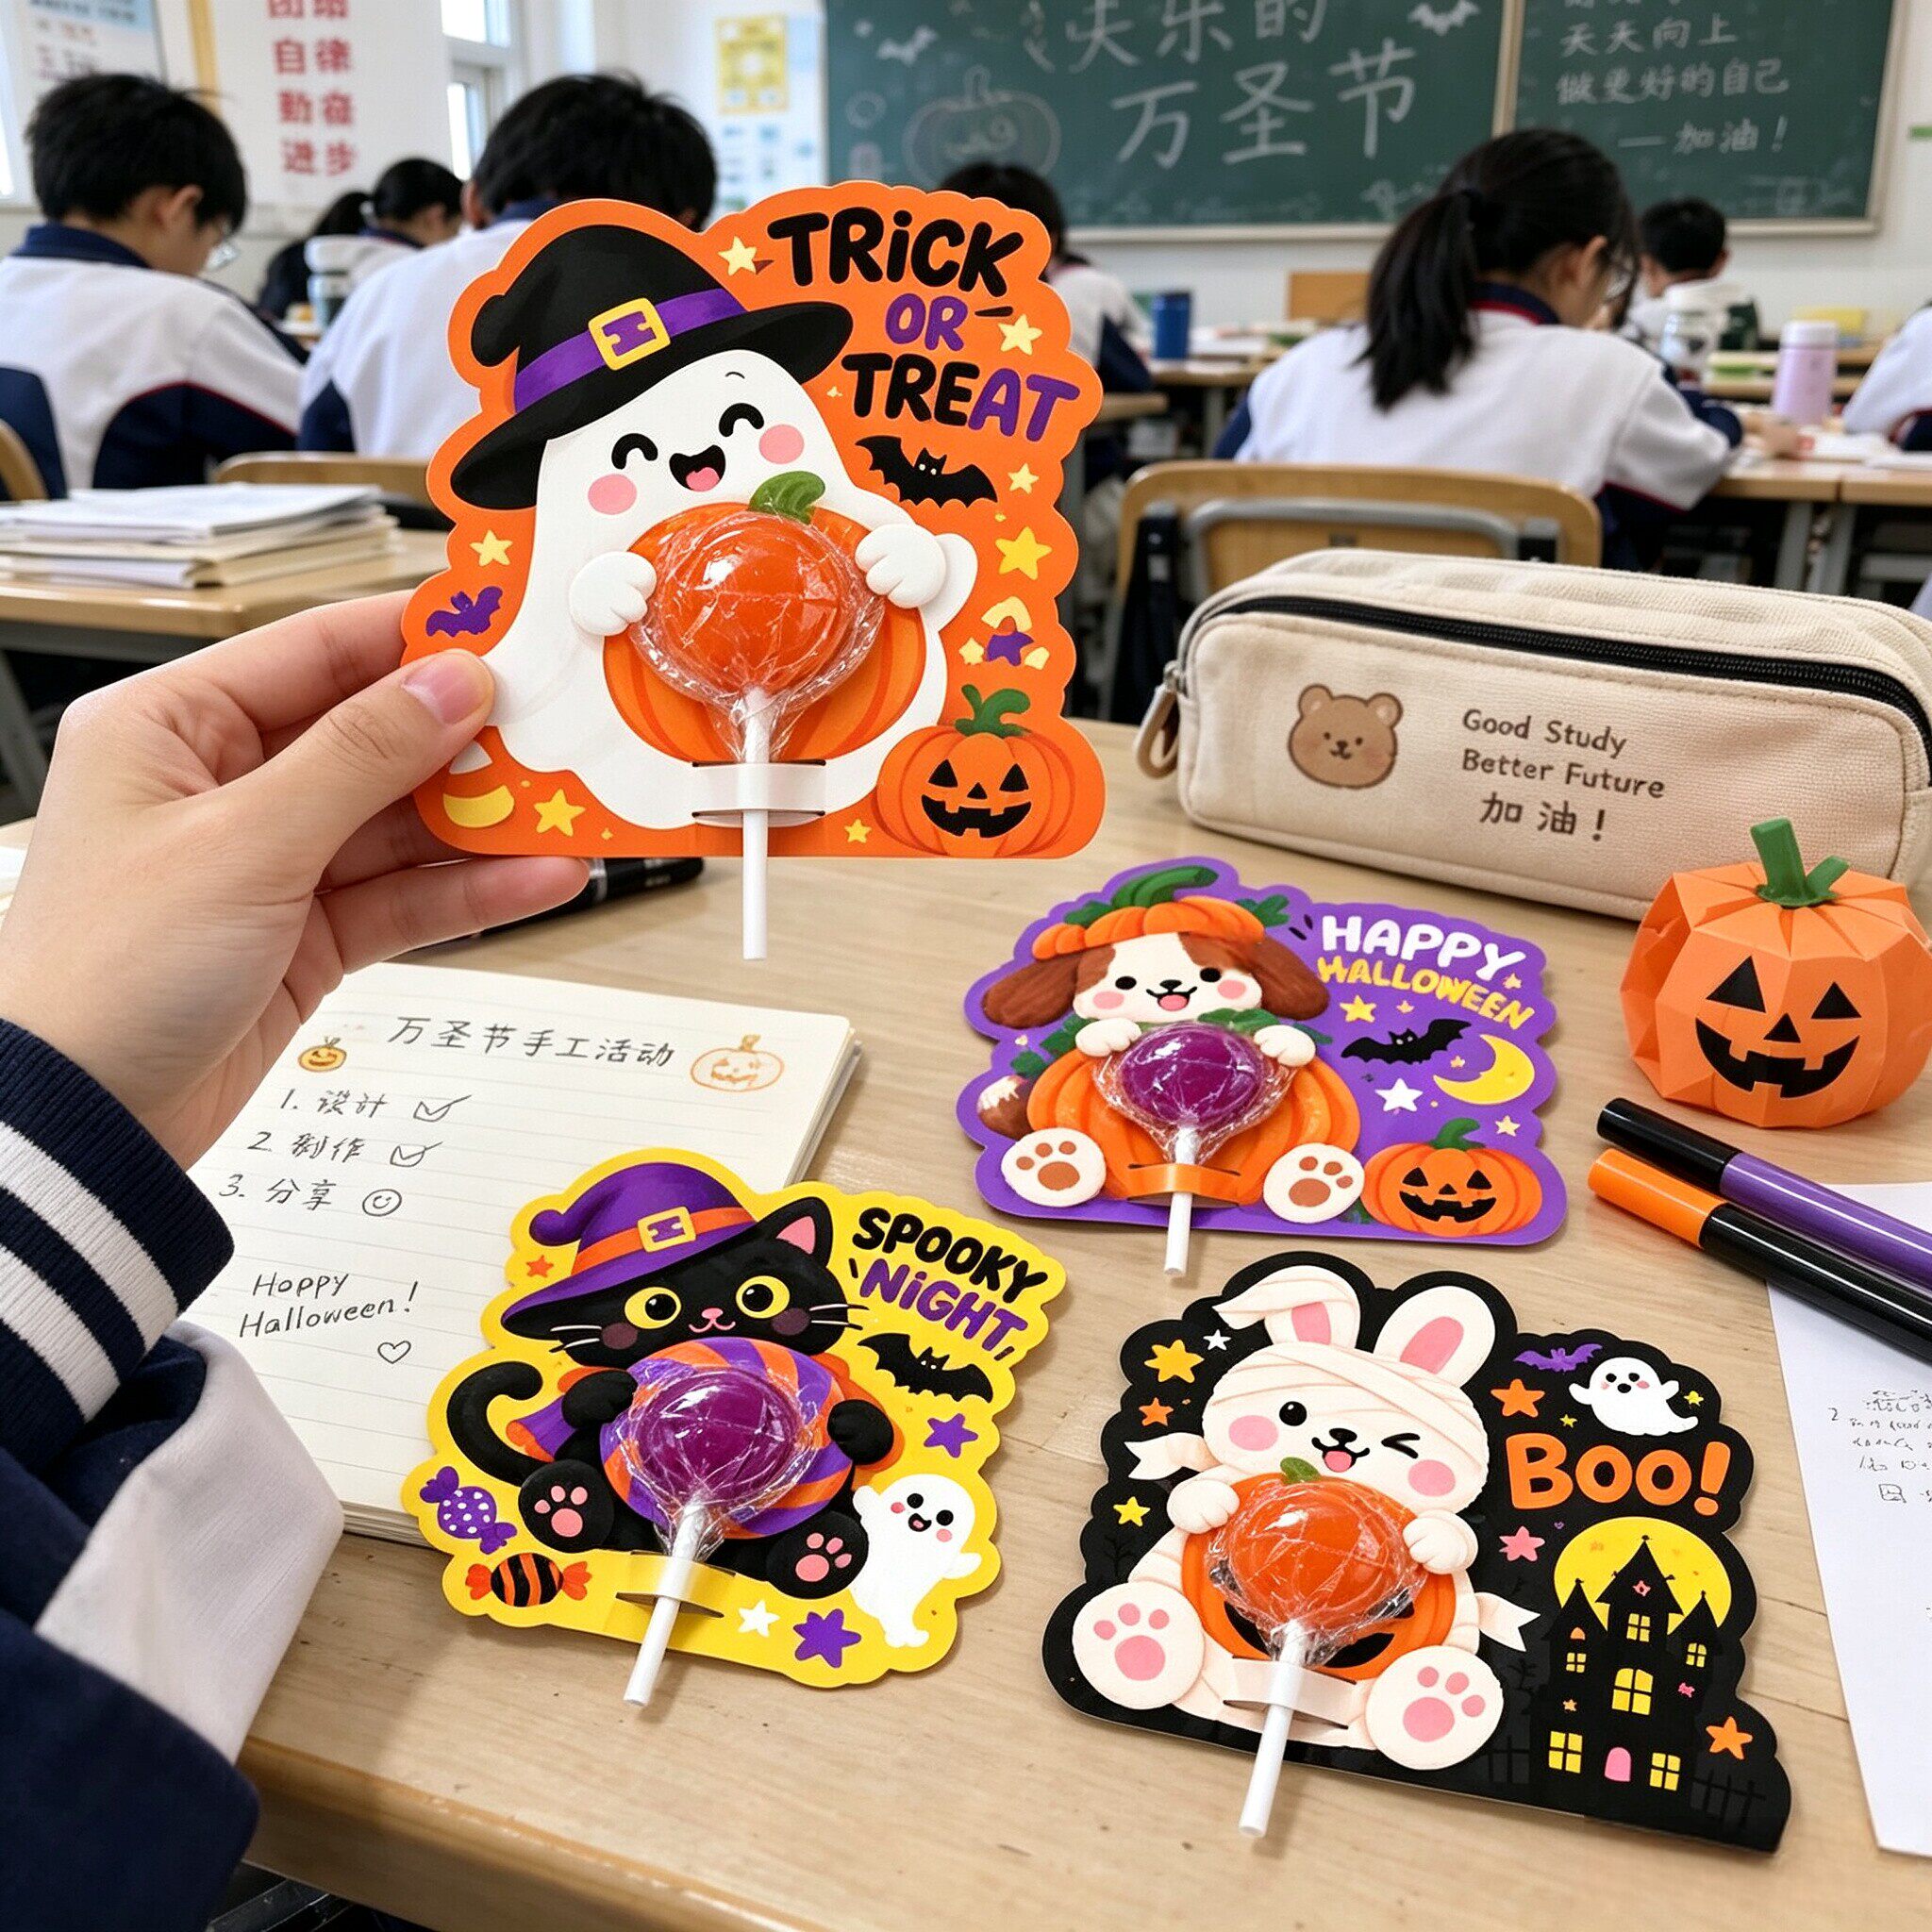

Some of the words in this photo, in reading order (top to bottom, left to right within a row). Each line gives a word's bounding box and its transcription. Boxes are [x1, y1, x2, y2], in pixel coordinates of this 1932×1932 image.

[1559, 13, 1739, 58] 天天向上
[1110, 37, 1417, 171] 万圣节
[1556, 58, 1790, 106] 做更好的自己
[885, 292, 969, 352] OR
[841, 352, 1081, 442] TREAT
[1462, 708, 1531, 740] Good
[1544, 720, 1627, 759] Study
[1462, 748, 1554, 781] Better
[1565, 762, 1665, 799] Future
[1479, 791, 1606, 842] 加油！
[1322, 915, 1526, 981] HAPPY
[1317, 956, 1535, 1030] HALLOWEEN
[388, 1017, 675, 1067] 万圣节手工活动
[265, 1178, 337, 1211] 分享
[852, 1207, 1048, 1304] SPOOKY
